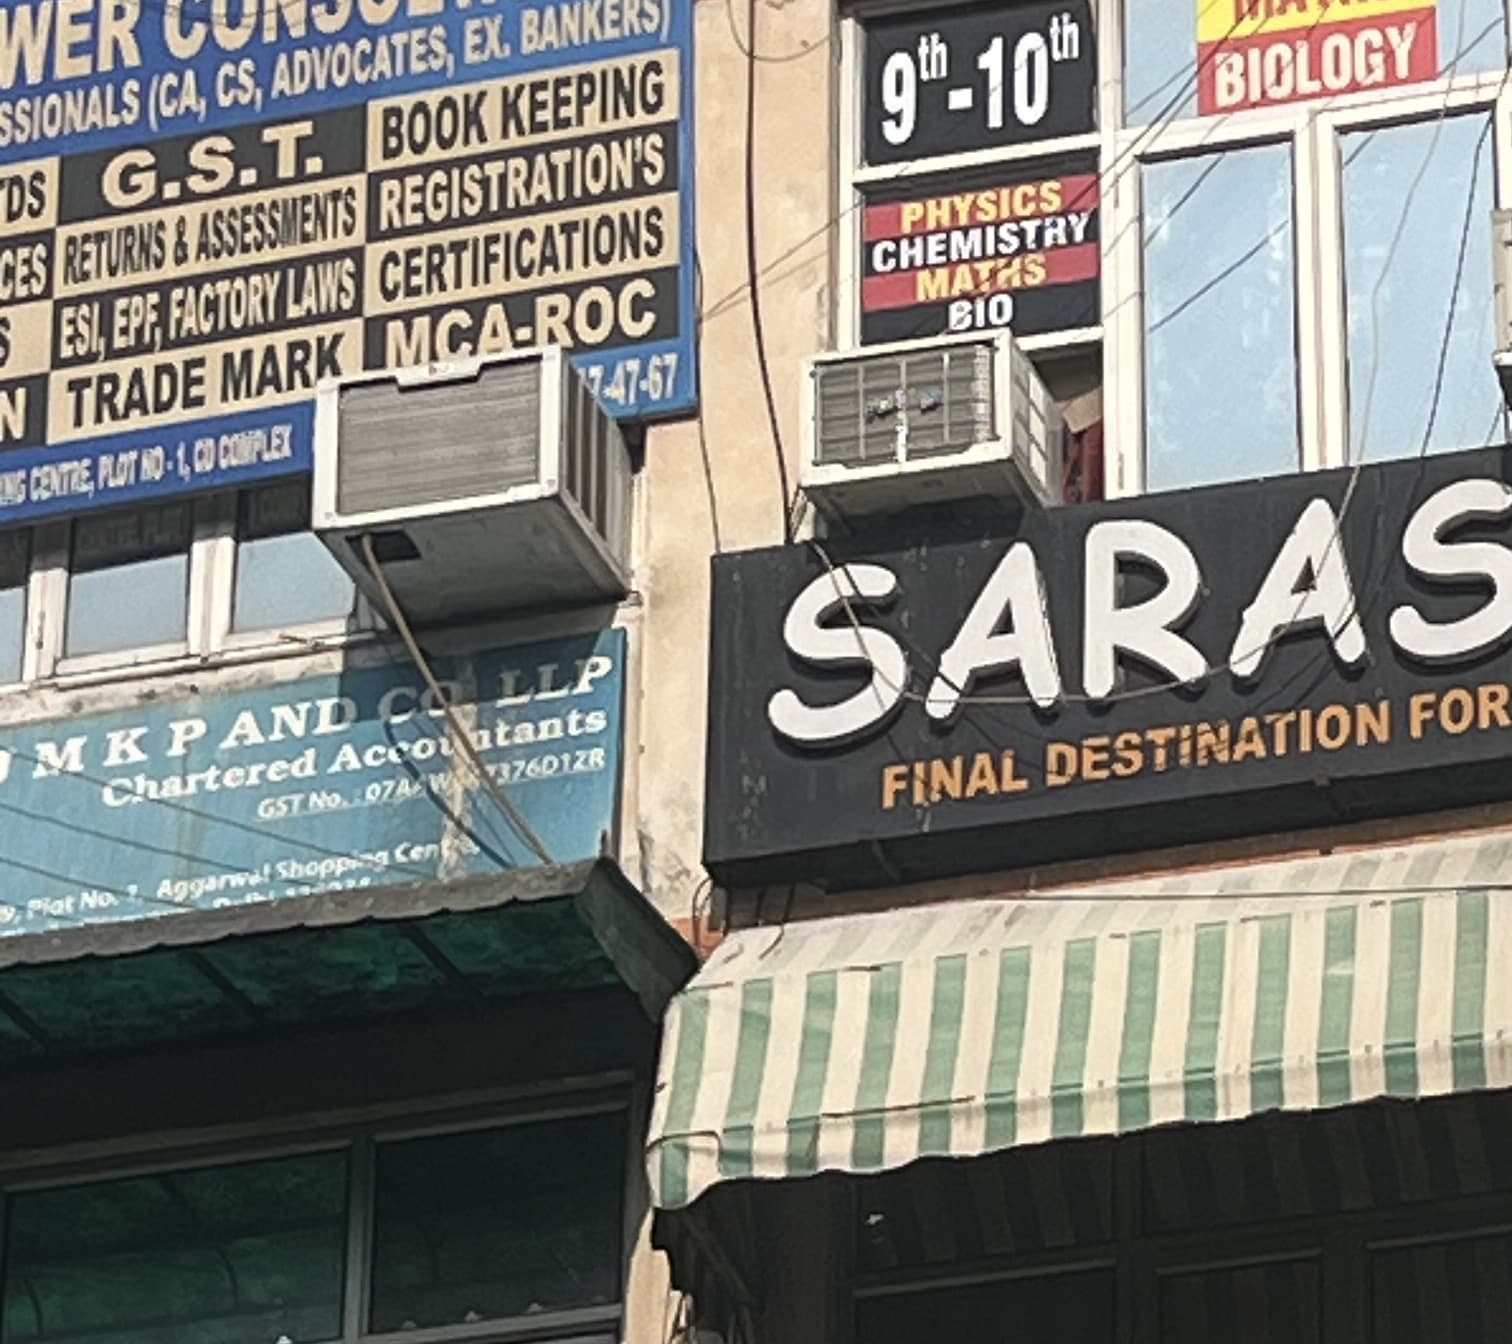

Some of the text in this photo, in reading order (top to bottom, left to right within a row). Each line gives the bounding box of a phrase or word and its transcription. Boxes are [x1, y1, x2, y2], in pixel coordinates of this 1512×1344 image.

[149, 69, 207, 132] (CA,
[216, 58, 263, 112] CS,
[272, 24, 455, 98] ADVOCATES,
[464, 13, 511, 64] EX.
[1214, 22, 1417, 108] BIOLOGY
[382, 60, 665, 160] BOOK KEEPING
[0, 170, 46, 224] DS
[103, 120, 324, 208] G.S.T.
[380, 132, 665, 232] REGISTRATION'S
[902, 180, 1062, 233] PHYSICS
[64, 186, 357, 285] RETURNS & ASSESSMENTS
[380, 205, 664, 303] CERTIFICATIONS
[872, 211, 1092, 273] CHEMISTRY
[916, 254, 1047, 302] MATHS
[60, 257, 357, 362] ESI, EPF, FACTORY LAWS
[386, 278, 656, 369] MCA-ROC
[947, 294, 1013, 331] BIO
[67, 332, 345, 429] TRADE MARK
[99, 450, 138, 490] PLOT
[219, 424, 293, 470] COMPLEX
[103, 726, 149, 767] K
[166, 719, 207, 757] P
[219, 696, 357, 749] AND
[496, 656, 613, 708] LLP
[881, 752, 1028, 809] FINAL
[1046, 698, 1391, 788] DESTINATION
[1410, 682, 1511, 739] FOR
[102, 748, 318, 807] Chartered
[257, 793, 304, 820] GST
[156, 863, 272, 905] Aggarwal
